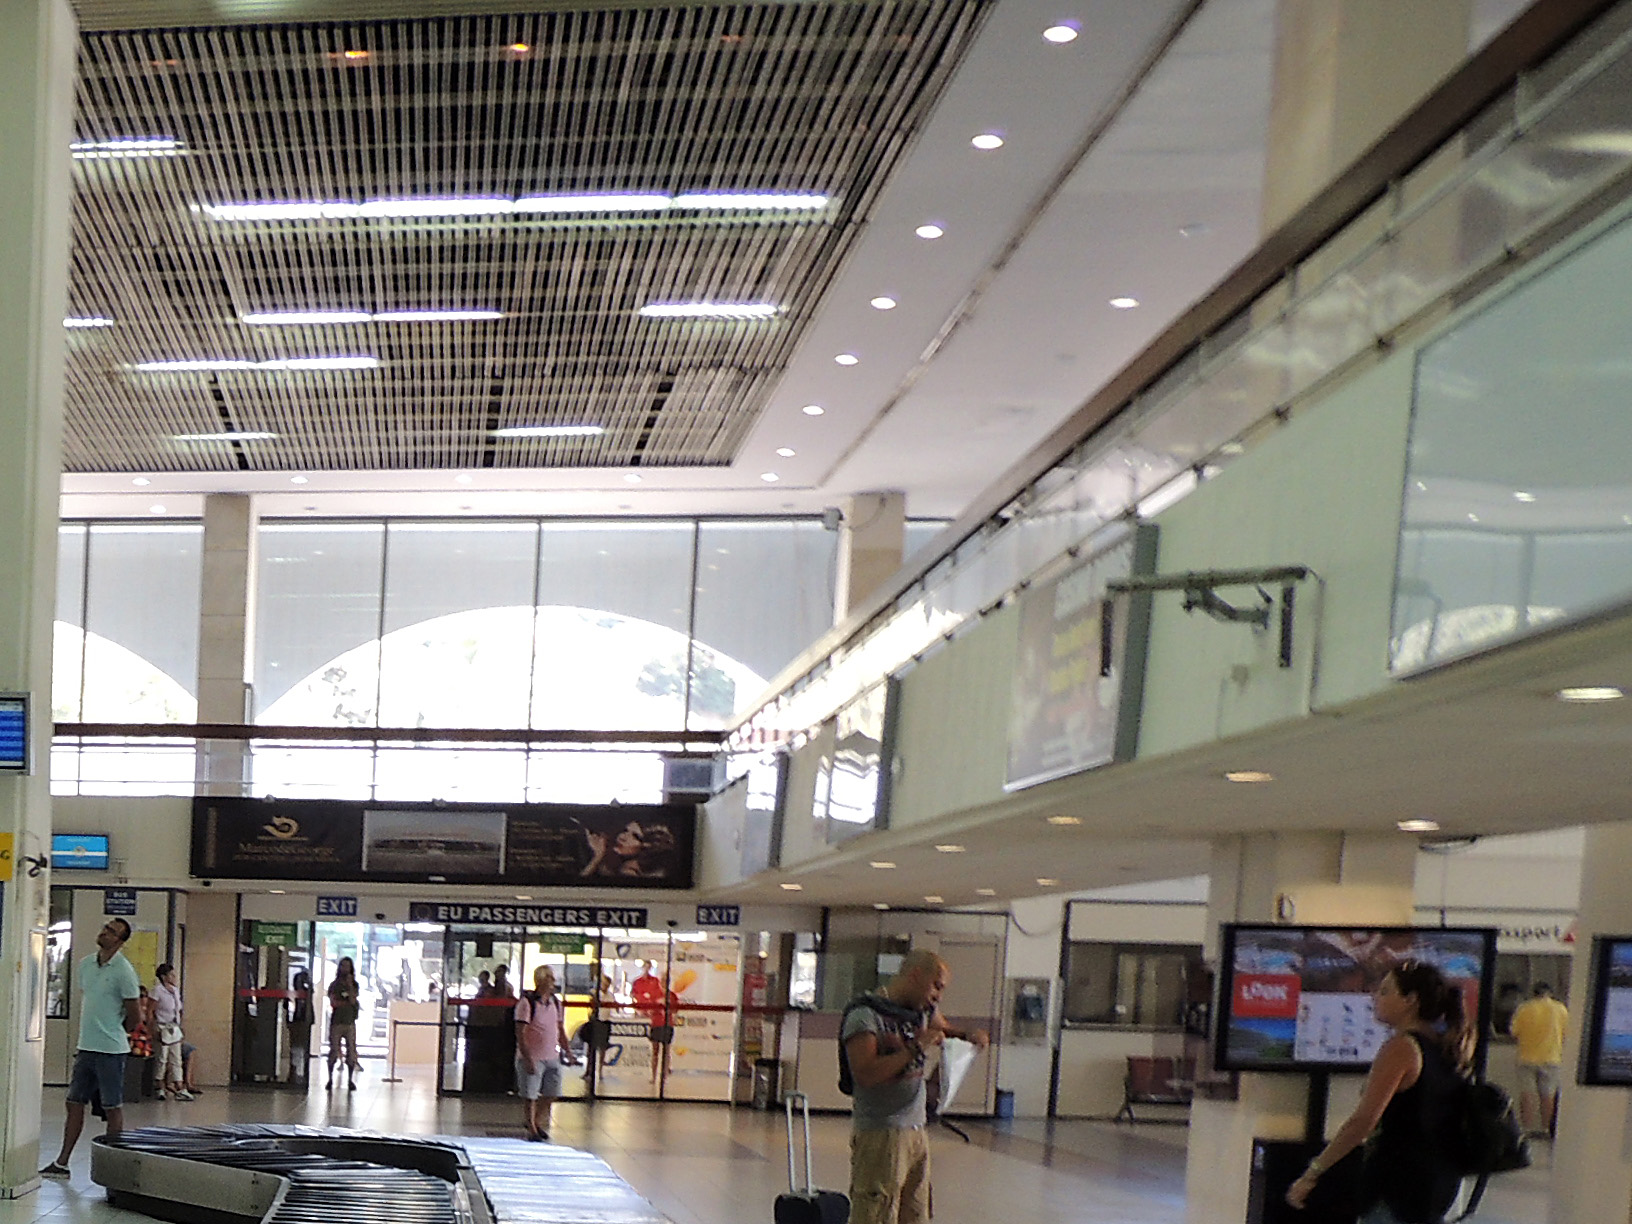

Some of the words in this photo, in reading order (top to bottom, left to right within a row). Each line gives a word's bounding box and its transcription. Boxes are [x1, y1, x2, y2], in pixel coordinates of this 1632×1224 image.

[318, 899, 357, 914] EXIT
[437, 905, 463, 920] EU
[468, 906, 590, 924] PASSENGERS
[595, 909, 641, 925] EXIT
[698, 907, 739, 924] EXIT
